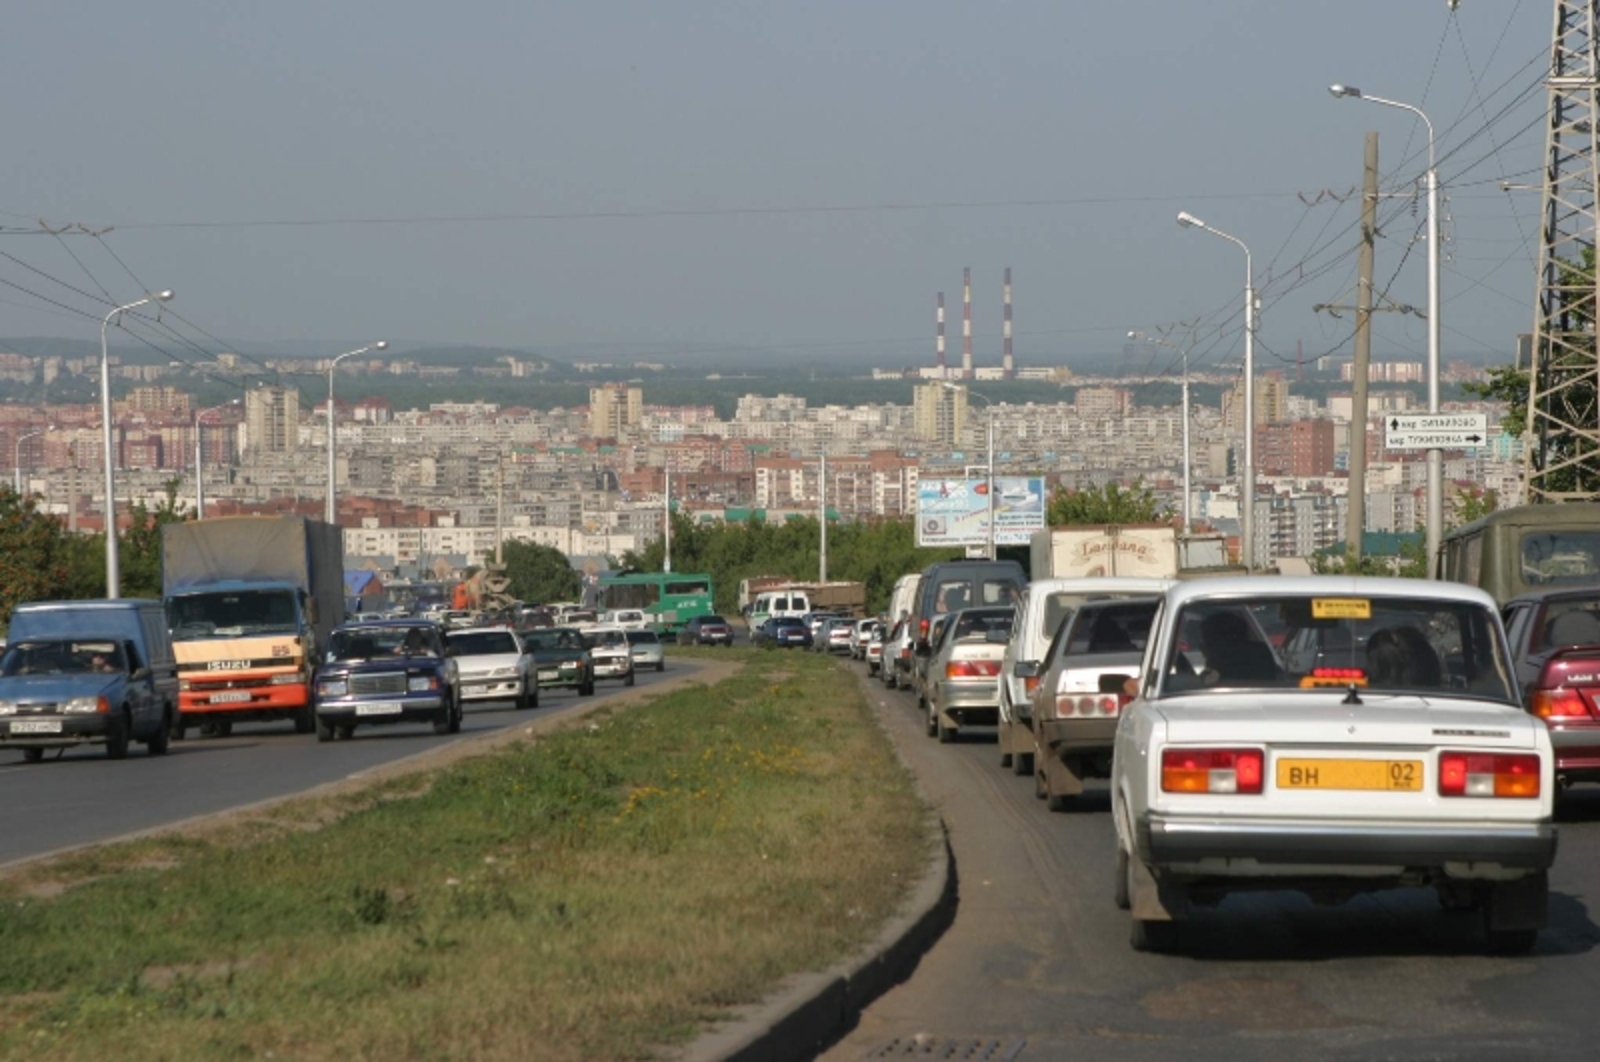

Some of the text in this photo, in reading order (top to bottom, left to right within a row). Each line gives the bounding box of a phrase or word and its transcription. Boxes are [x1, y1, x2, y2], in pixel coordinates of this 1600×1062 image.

[207, 659, 251, 671] ISUZU
[1289, 762, 1415, 785] BH 02
